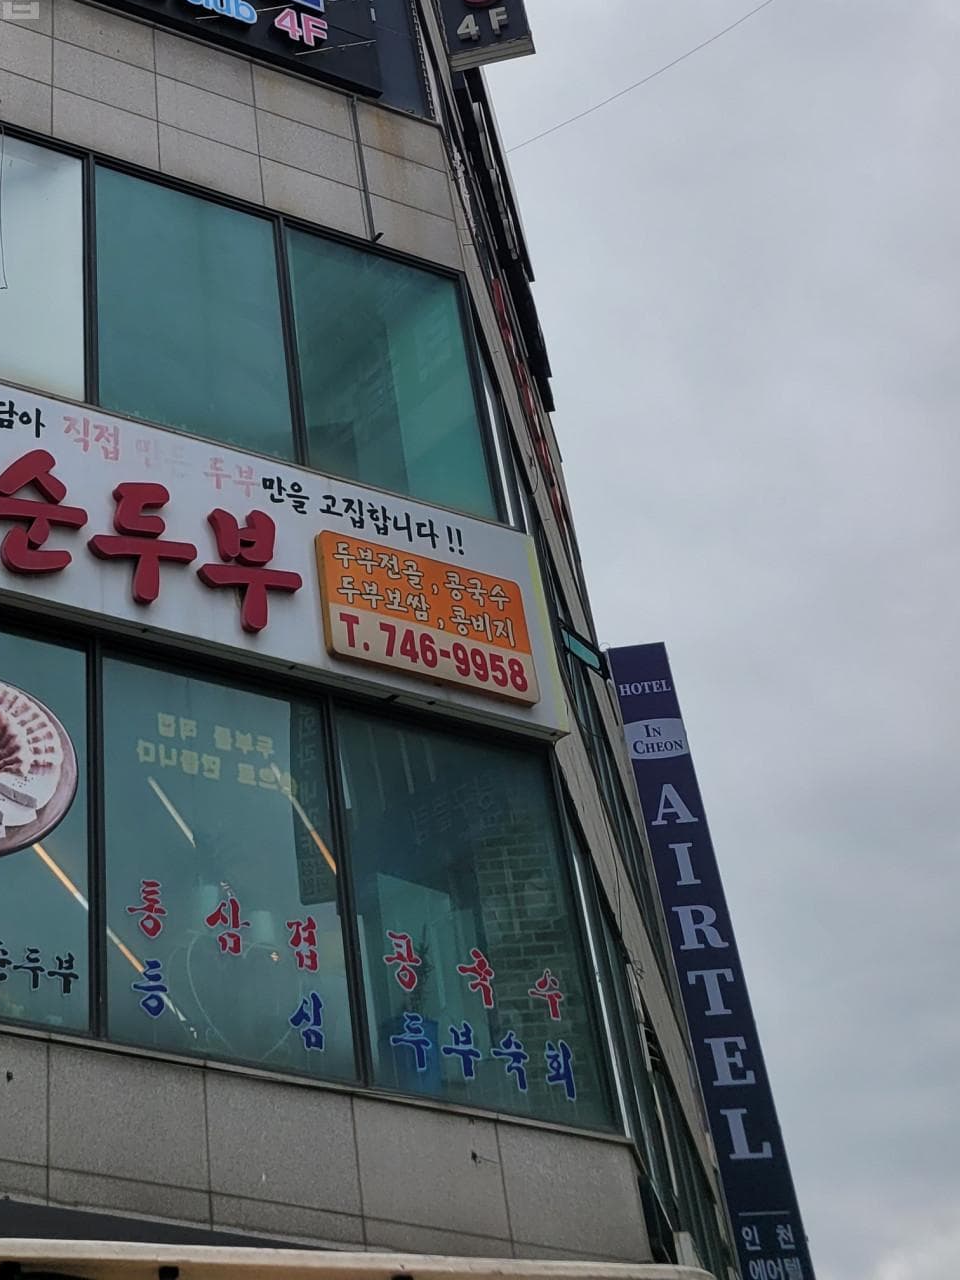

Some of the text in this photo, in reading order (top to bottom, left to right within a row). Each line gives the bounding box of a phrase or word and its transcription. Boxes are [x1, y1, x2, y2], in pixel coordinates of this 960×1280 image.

[274, 8, 328, 47] 4F
[457, 7, 508, 41] 4F
[62, 413, 121, 462] 직접
[319, 493, 441, 550] 고집합니다
[444, 571, 511, 611] 콩국수
[451, 605, 516, 648] 콩비지
[619, 680, 671, 696] HOTEL
[127, 880, 320, 973] 통삼겹
[384, 931, 565, 1020] 콩국수
[651, 783, 772, 1160] AIRTEL
[390, 1011, 578, 1102] 두부숙회
